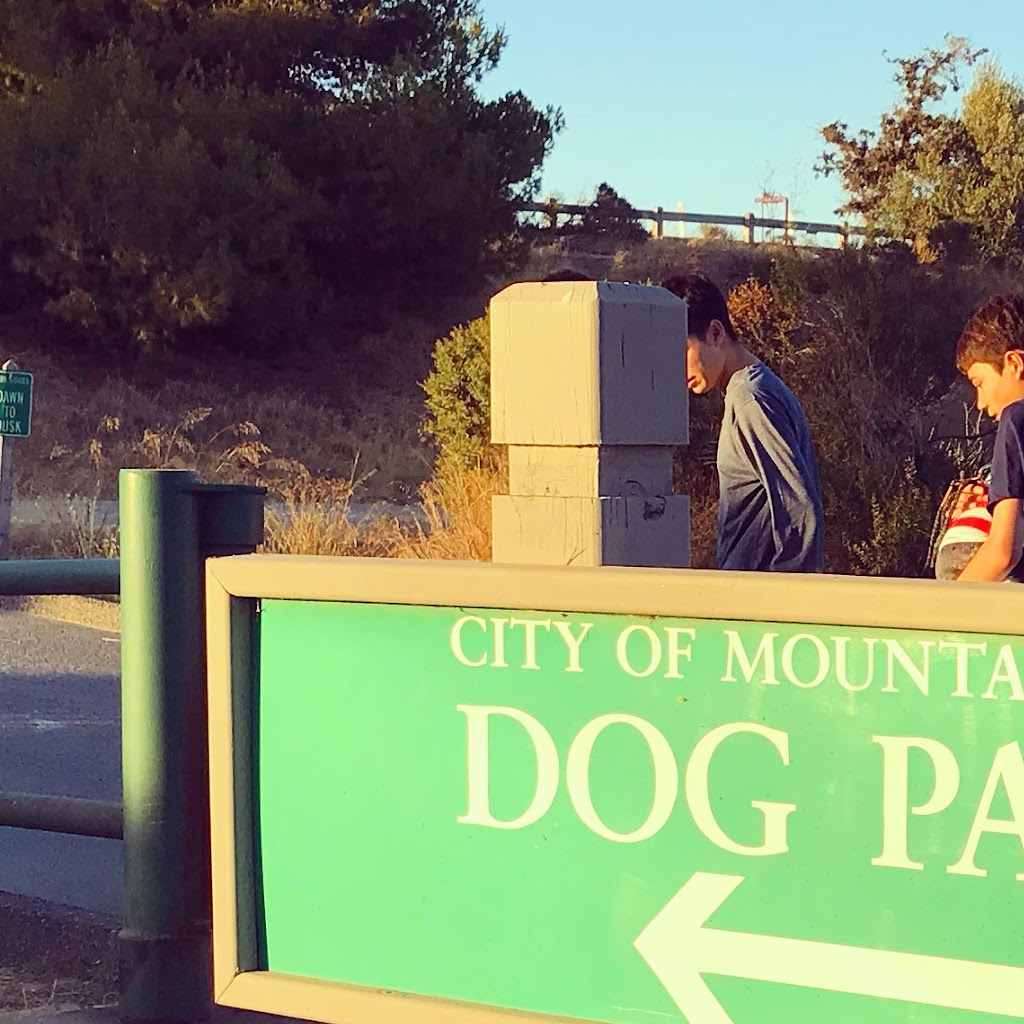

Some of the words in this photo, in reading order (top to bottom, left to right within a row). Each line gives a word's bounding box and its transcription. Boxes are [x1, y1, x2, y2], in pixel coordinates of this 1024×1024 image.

[4, 405, 16, 418] TO
[450, 609, 593, 677] CITY
[616, 615, 697, 680] OF
[456, 704, 796, 858] DOG
